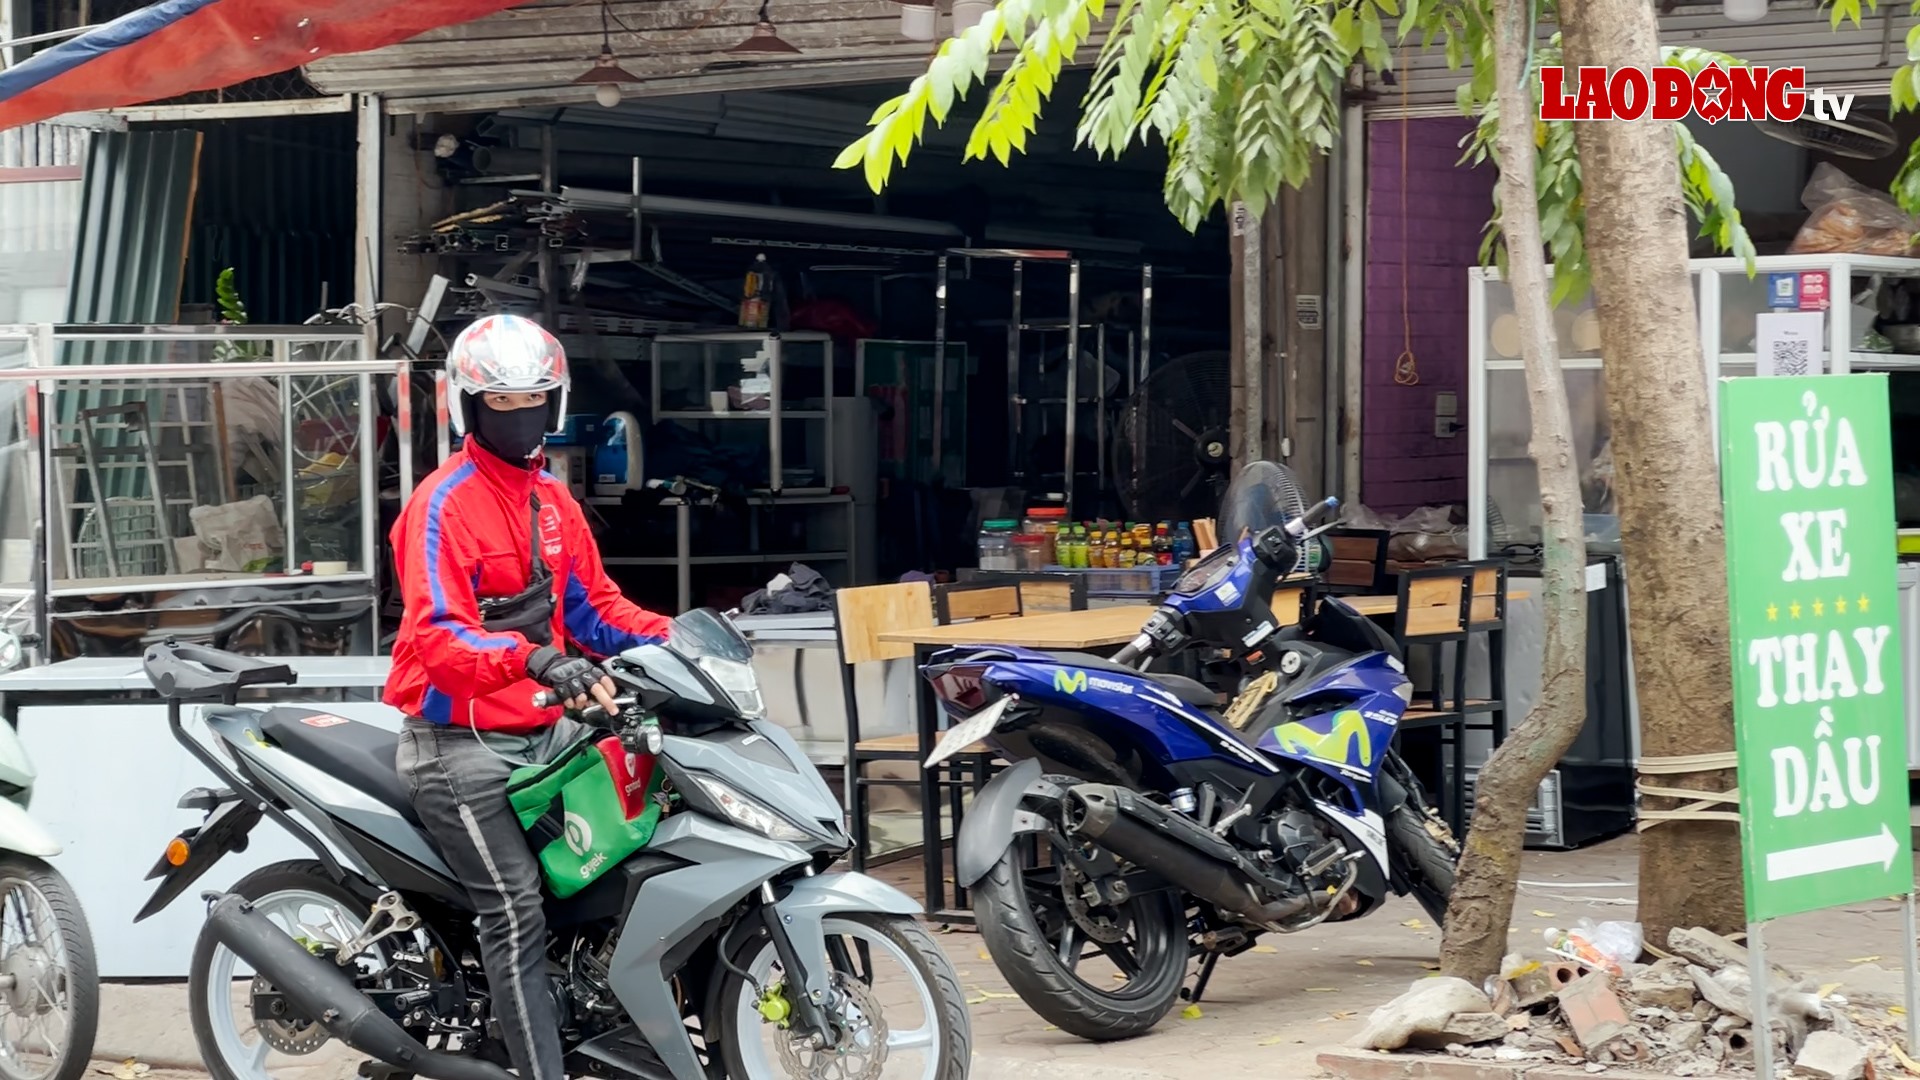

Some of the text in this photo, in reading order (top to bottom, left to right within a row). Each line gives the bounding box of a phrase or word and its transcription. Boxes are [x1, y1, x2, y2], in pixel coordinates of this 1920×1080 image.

[1753, 389, 1869, 492] RỬA
[1779, 507, 1851, 582] XE
[1747, 624, 1891, 708] THAY
[1770, 705, 1882, 818] DẦU
[579, 851, 609, 879] gojek
